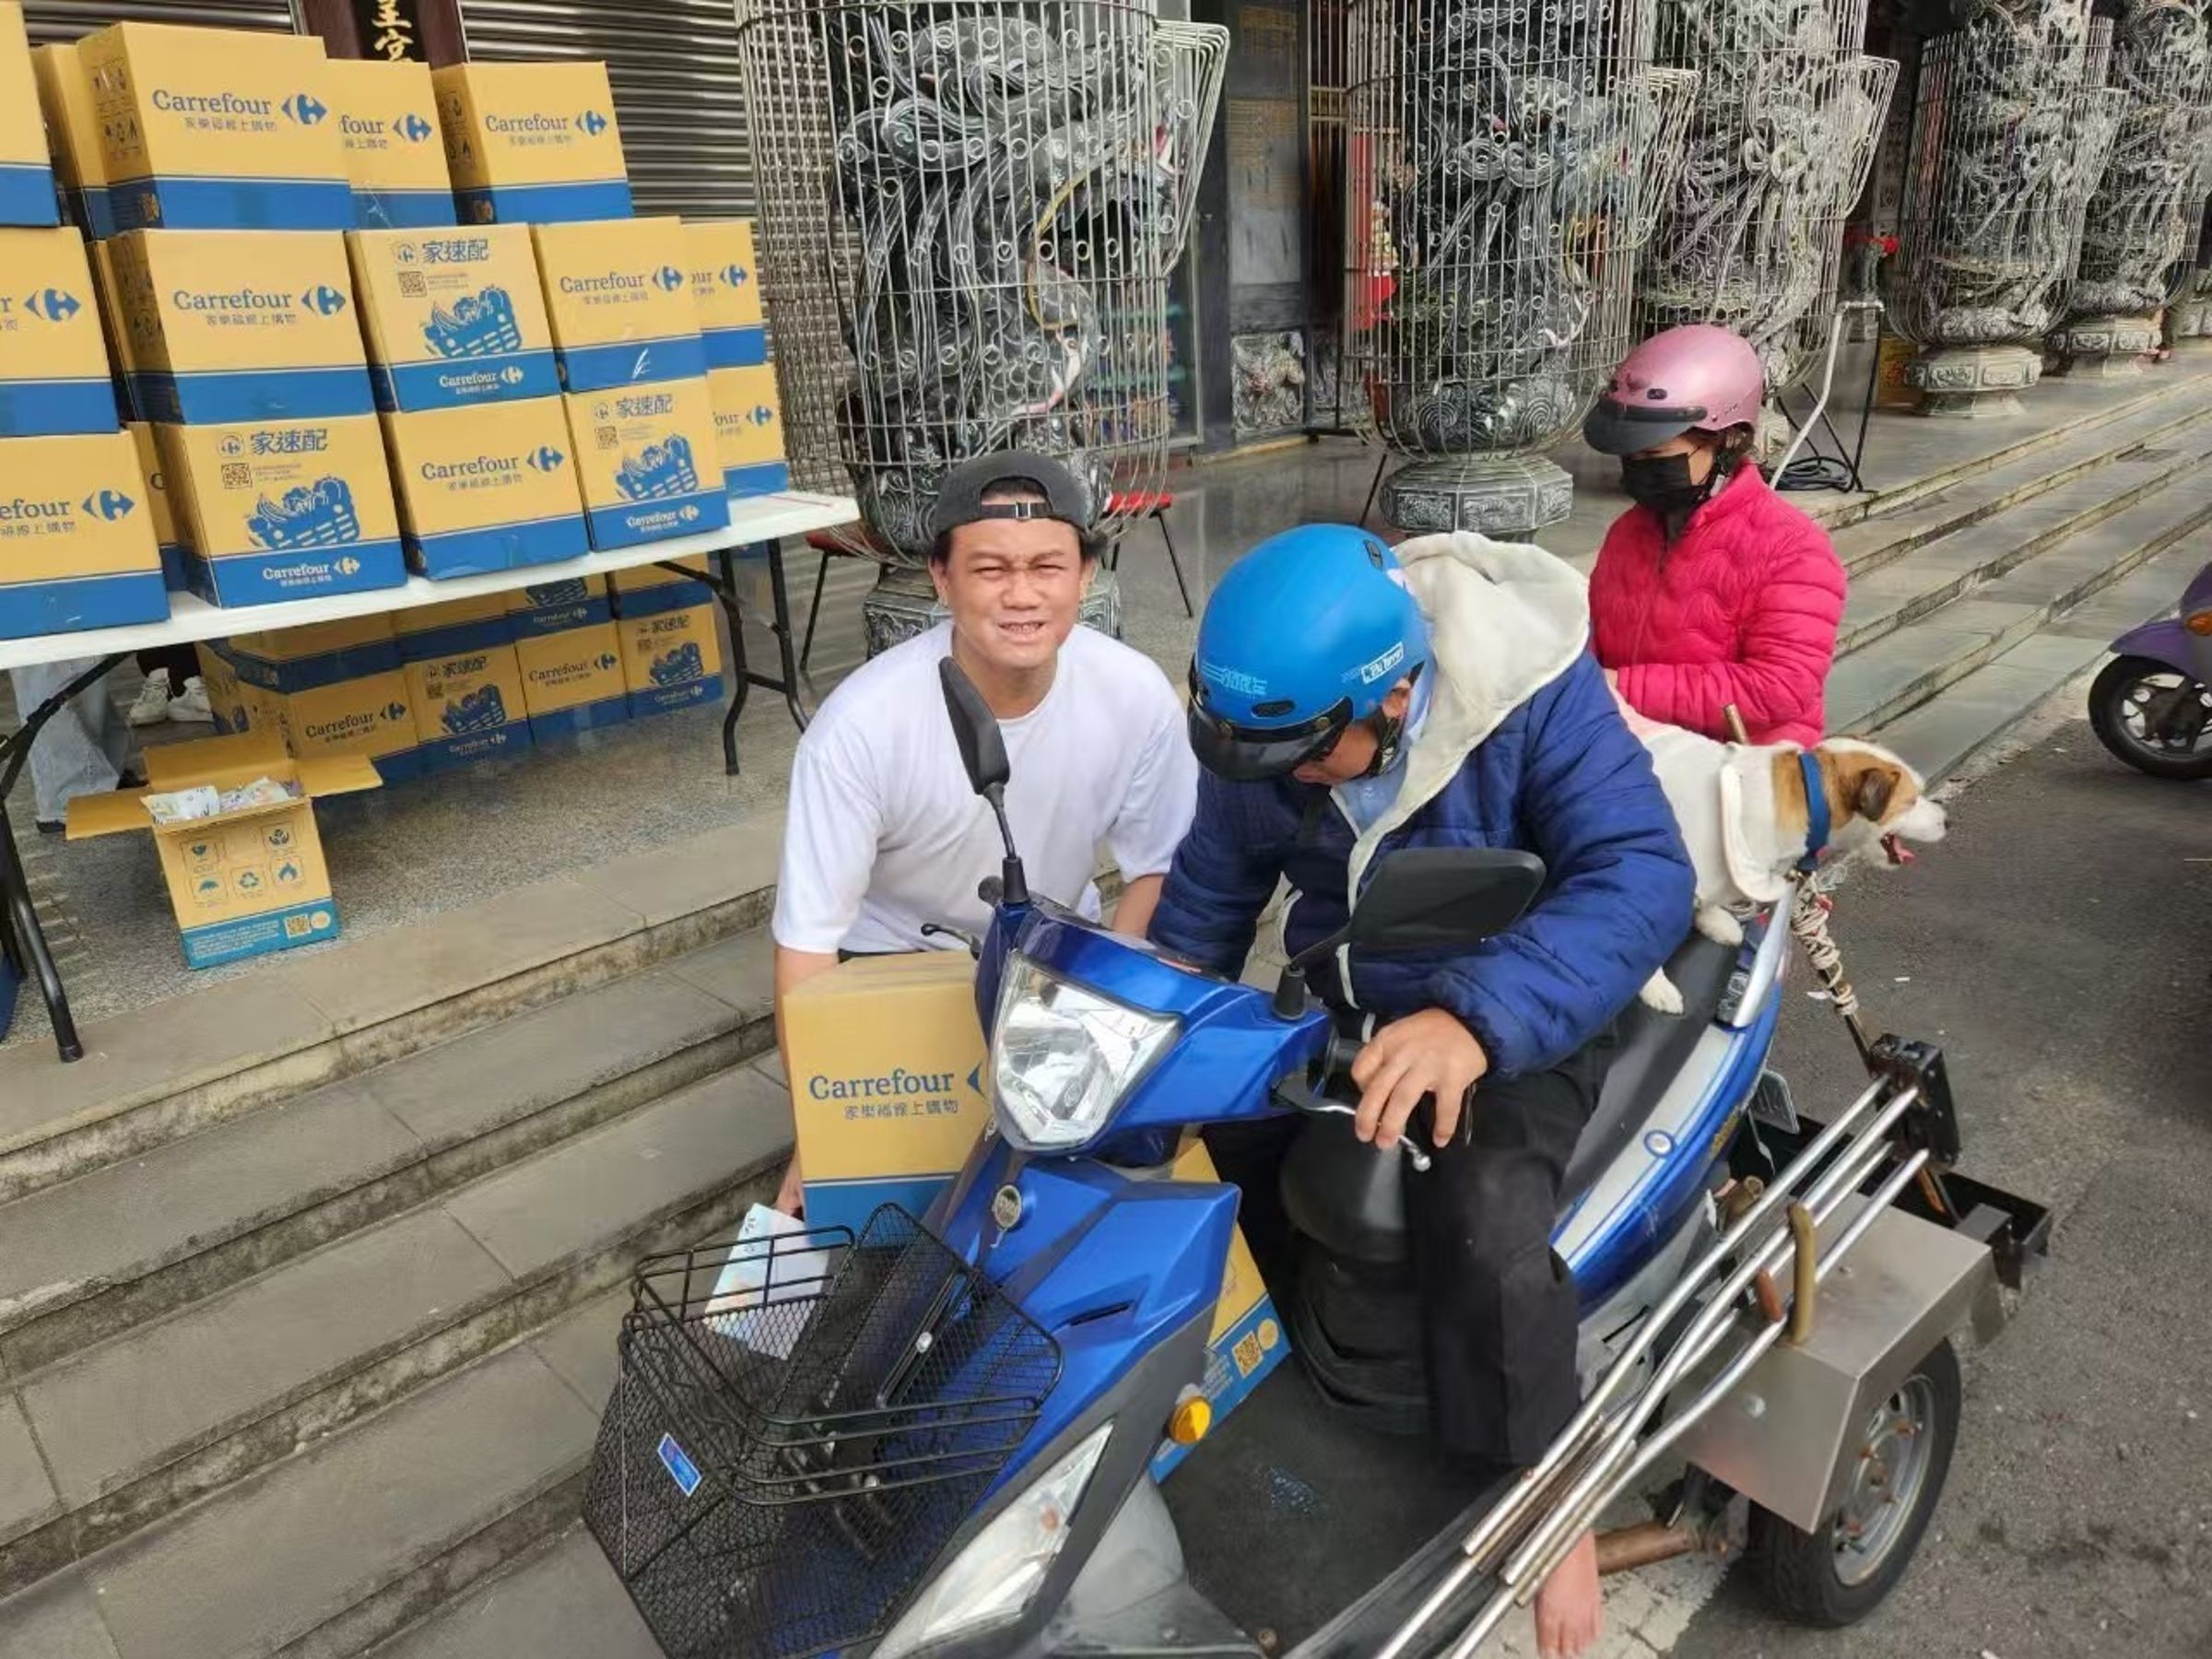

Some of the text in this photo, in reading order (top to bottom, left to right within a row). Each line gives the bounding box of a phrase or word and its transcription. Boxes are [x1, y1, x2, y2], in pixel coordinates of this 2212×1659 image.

[152, 88, 271, 115] Carrefour
[485, 115, 570, 133] Carrefour
[422, 238, 490, 264] 家速配
[559, 270, 645, 294] Carrefour
[172, 288, 292, 311] Carrefour
[439, 372, 498, 388] Carrefour
[249, 428, 329, 456] 家速配
[420, 455, 521, 481] Carrefour
[262, 562, 330, 582] Carrefour
[528, 662, 589, 683] Carrefour
[305, 711, 374, 739] Carrefour
[808, 1066, 955, 1101] Carrefour
